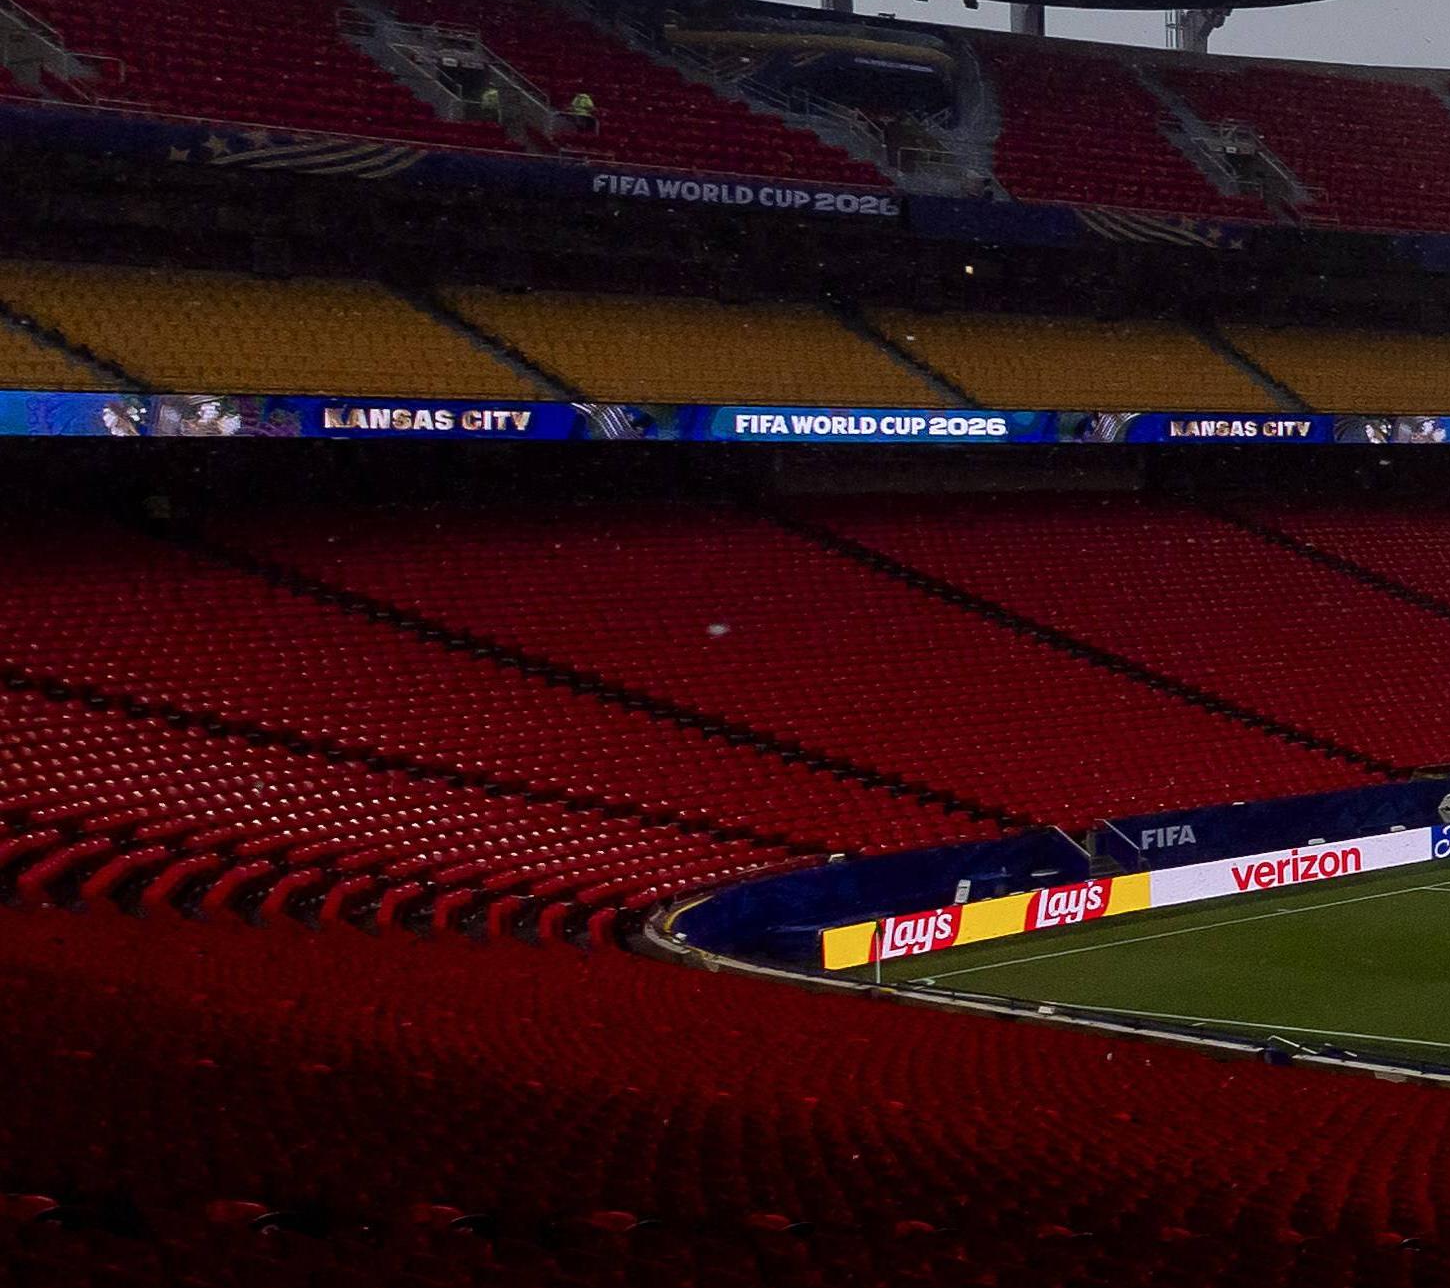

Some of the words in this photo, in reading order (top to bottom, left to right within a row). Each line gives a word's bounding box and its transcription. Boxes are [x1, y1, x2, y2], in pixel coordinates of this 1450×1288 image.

[592, 174, 650, 196] FIFA
[655, 179, 753, 205] WORLD
[759, 187, 811, 209] CUP
[815, 193, 899, 216] 2026
[324, 408, 455, 430] KANSAS
[461, 410, 531, 431] CITY
[735, 414, 789, 434] FIFA
[790, 415, 878, 434] WORLD
[880, 416, 926, 435] CUP
[928, 417, 1007, 435] 2026
[1170, 421, 1257, 437] KANSAS
[1262, 421, 1312, 437] CITY
[1141, 824, 1197, 850] FIFA
[1232, 847, 1362, 891] verizon
[1035, 881, 1104, 929] Lay's
[880, 908, 953, 960] Lay's
